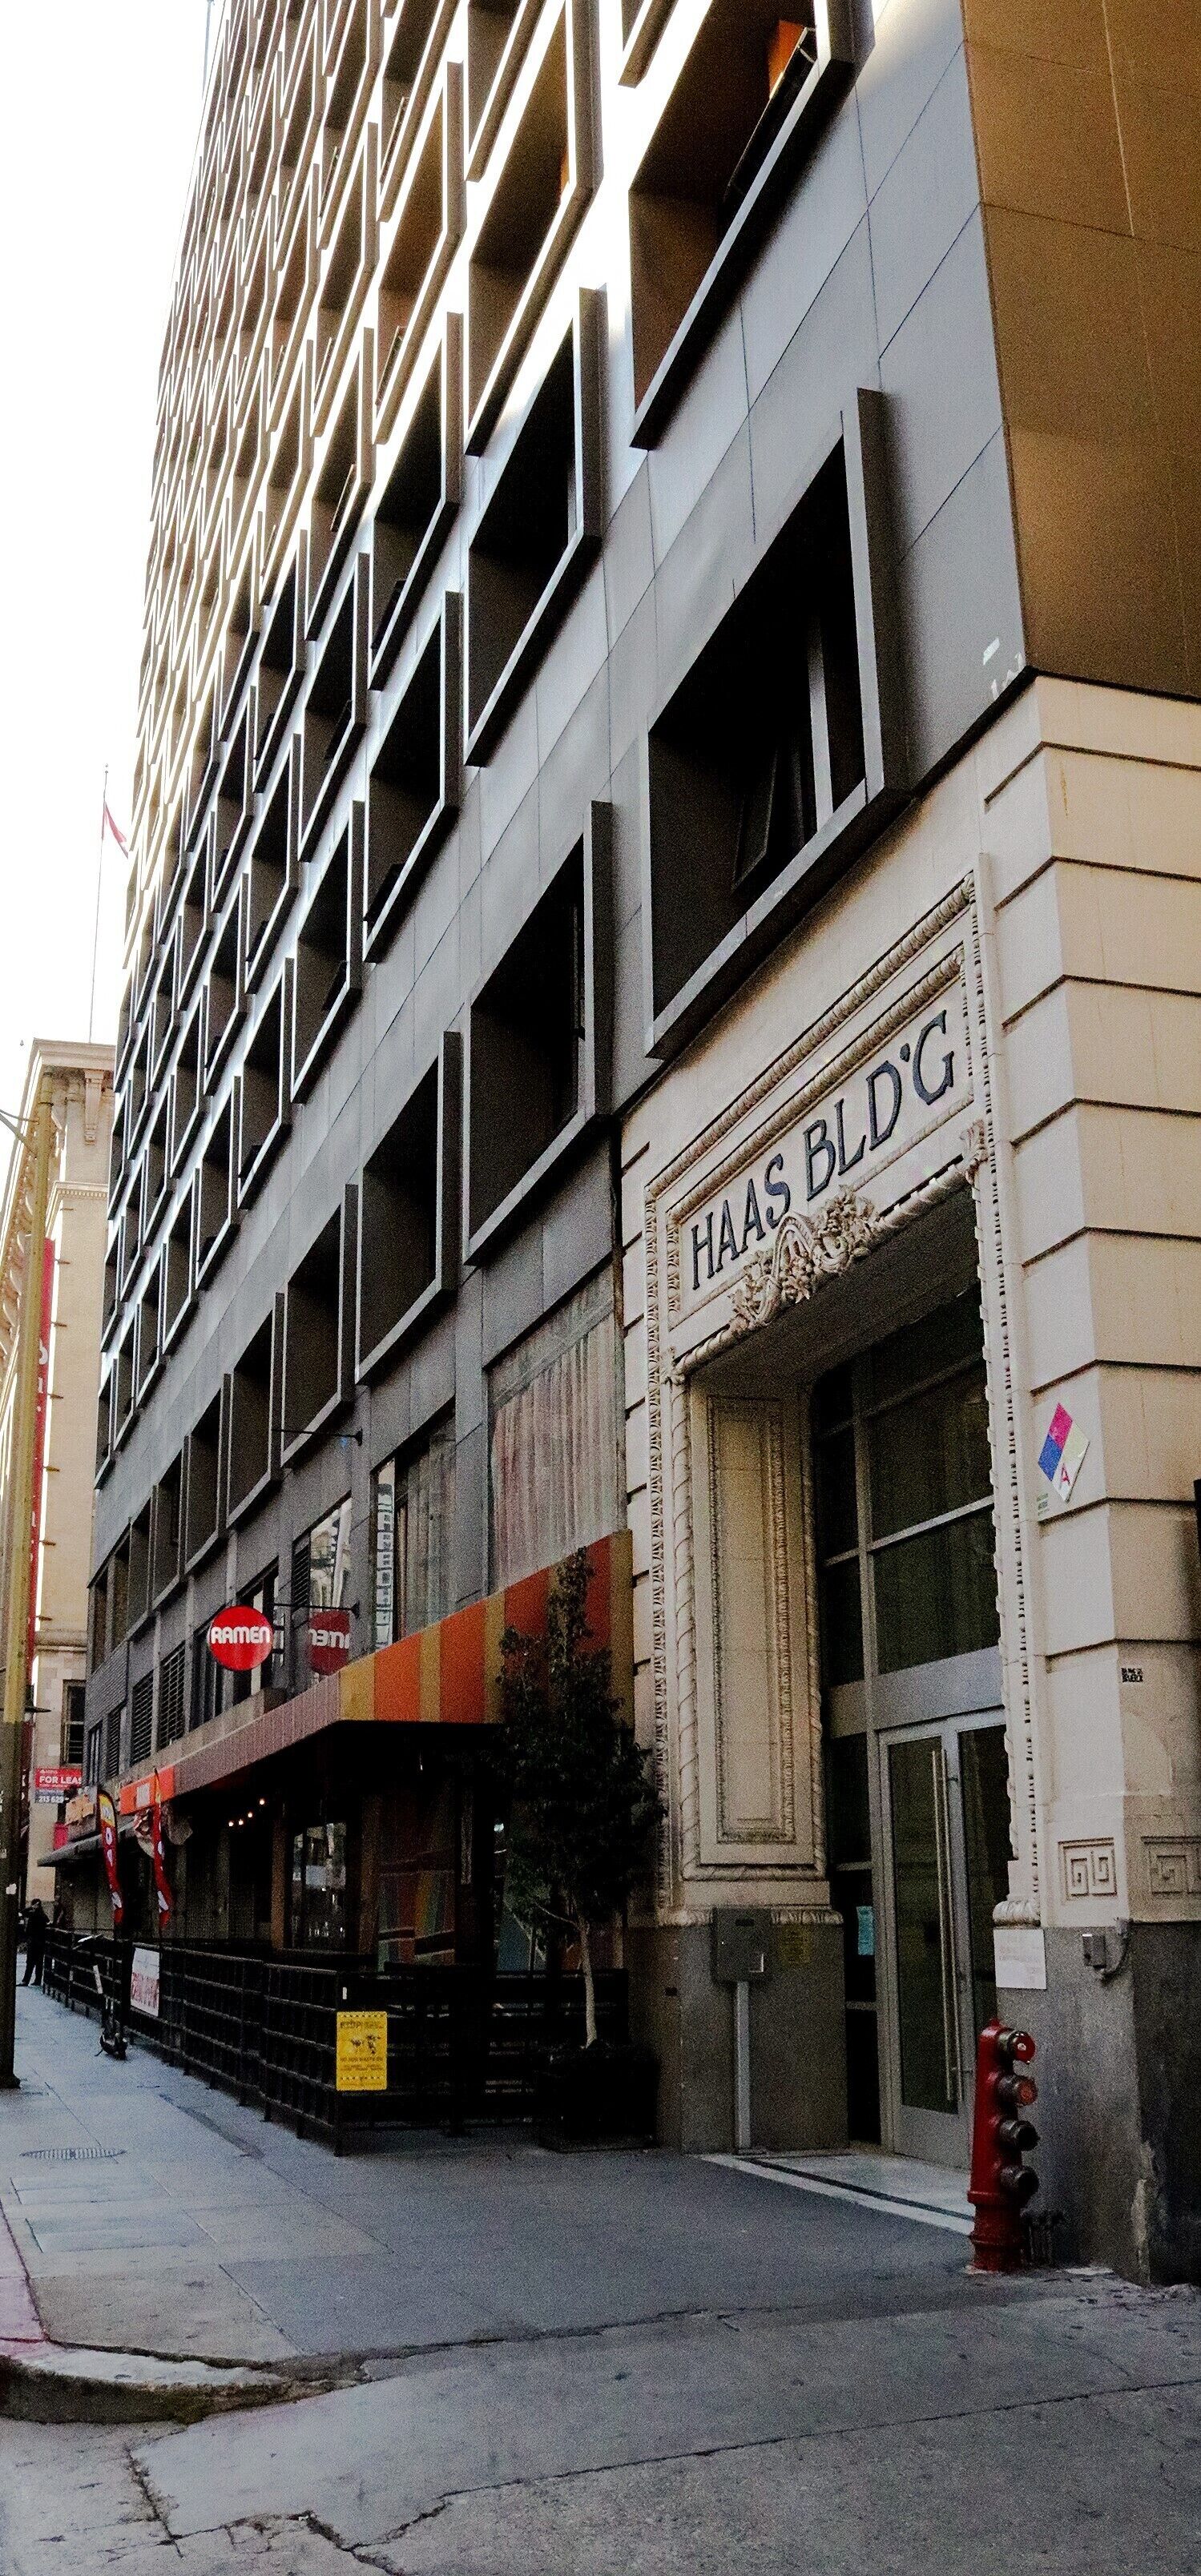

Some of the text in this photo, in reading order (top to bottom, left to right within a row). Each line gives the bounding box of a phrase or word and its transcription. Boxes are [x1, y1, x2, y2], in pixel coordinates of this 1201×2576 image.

[691, 1153, 791, 1290] HAAS
[211, 1626, 270, 1644] RAMEN
[39, 1776, 58, 1784] FOR
